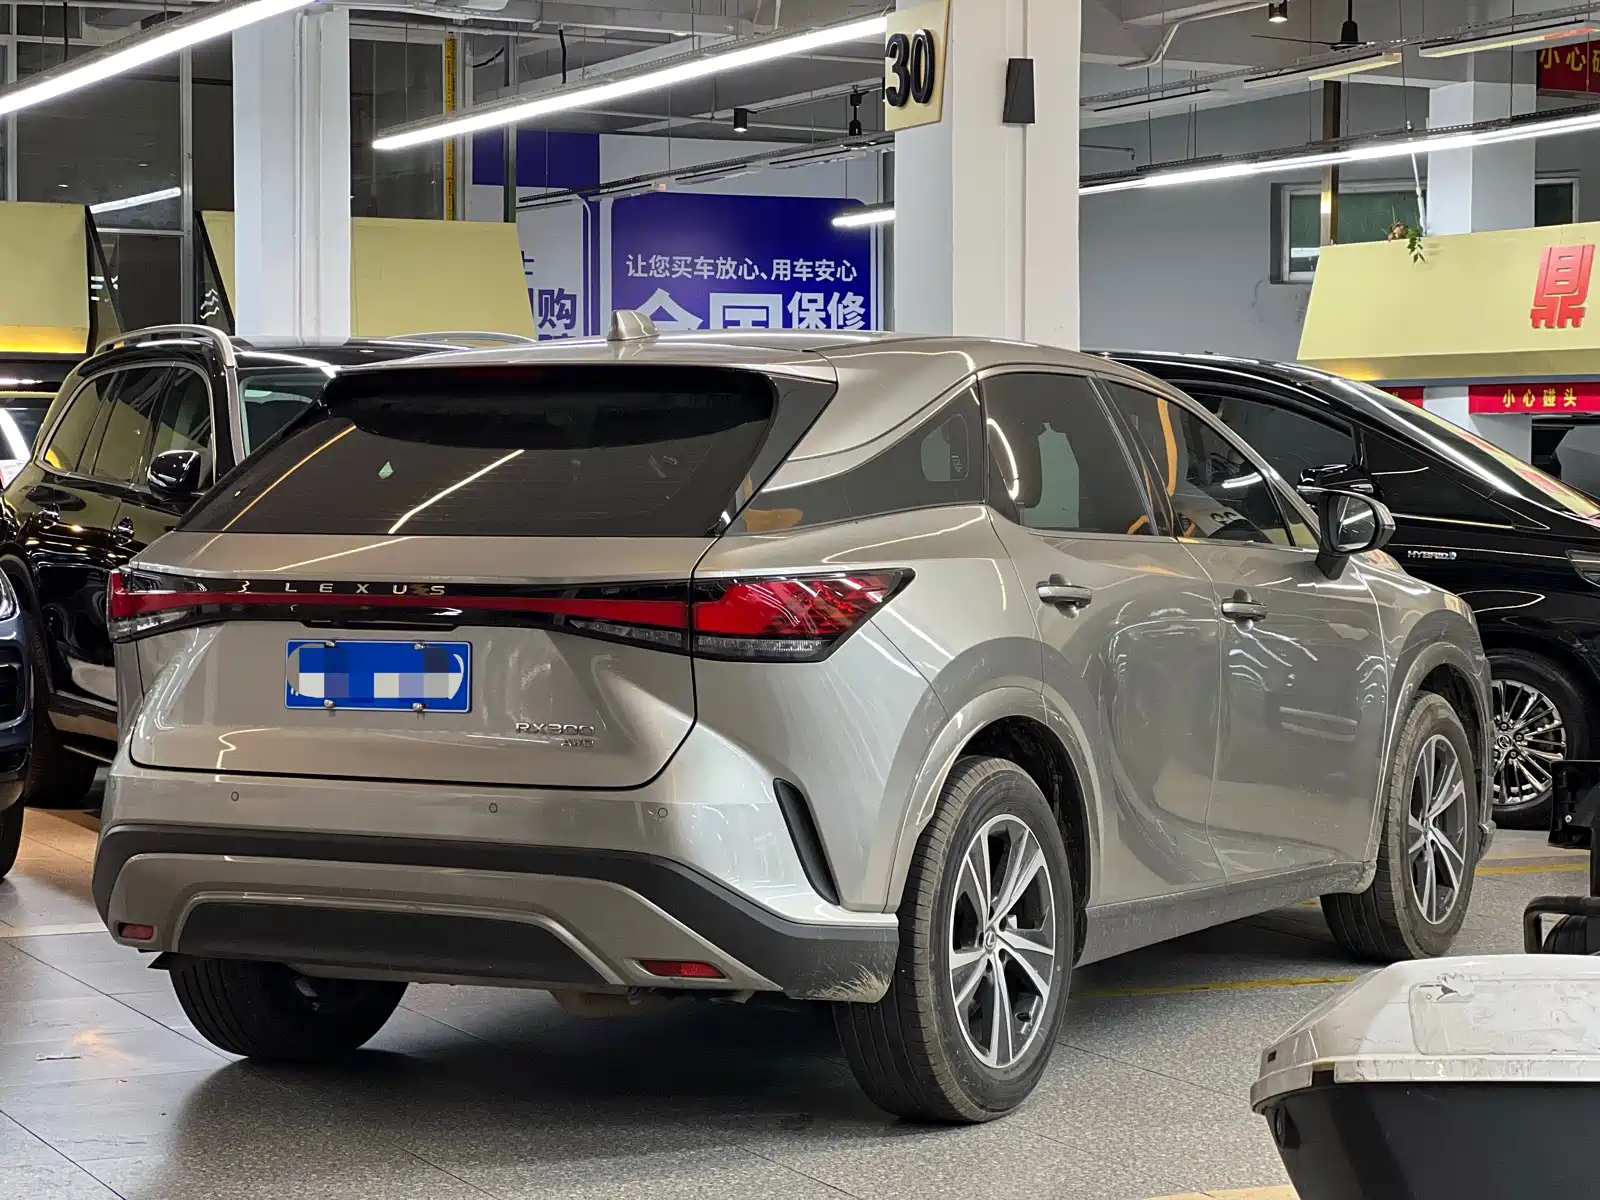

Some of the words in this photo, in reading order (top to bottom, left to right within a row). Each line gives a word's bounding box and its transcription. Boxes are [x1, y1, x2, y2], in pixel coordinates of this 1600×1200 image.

[885, 28, 935, 107] 30
[626, 254, 858, 282] 让您买车放心、用车安心
[527, 287, 577, 330] 购
[1502, 387, 1577, 408] 小心碰头
[1407, 550, 1449, 560] HYBRID
[284, 582, 446, 596] LEXUS
